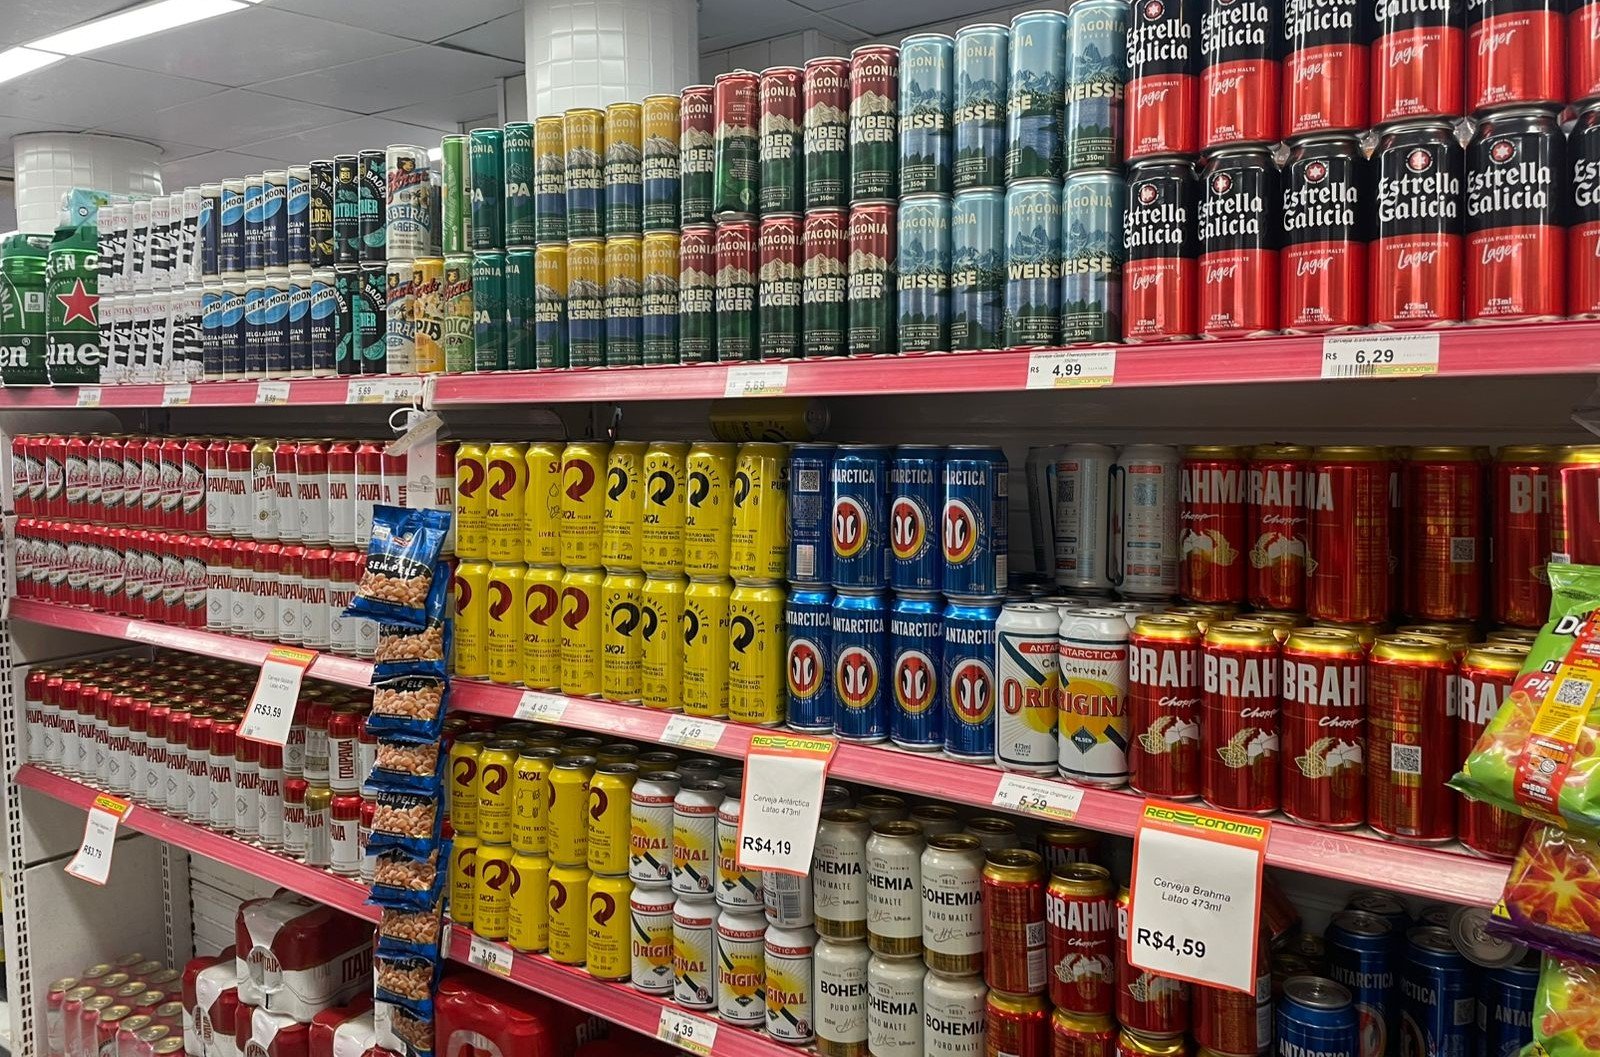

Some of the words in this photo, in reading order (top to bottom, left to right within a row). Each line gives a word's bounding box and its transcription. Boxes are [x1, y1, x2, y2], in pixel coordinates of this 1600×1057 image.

[1200, 2, 1268, 35] Estrella
[1284, 6, 1353, 40] Galicia
[1126, 19, 1192, 49] Estrella
[1201, 24, 1265, 55] Galicia
[1126, 39, 1189, 68] Galicia
[1377, 172, 1460, 203] Estrella
[1467, 162, 1551, 193] Estrella
[1198, 192, 1263, 222] Estrella
[1283, 182, 1358, 211] Estrella
[1467, 185, 1548, 217] Galicia
[1123, 203, 1187, 229] Estrella
[1284, 205, 1355, 232] Galicia
[1379, 195, 1458, 223] Galicia
[1124, 223, 1184, 250] Galicia
[1198, 212, 1260, 241] Galicia
[1398, 248, 1438, 269] Lager
[1482, 242, 1523, 265] Lager
[1008, 259, 1060, 280] WEISS
[1206, 264, 1239, 284] Lager
[1296, 256, 1334, 277] Lager
[1355, 349, 1395, 364] 6,29
[1030, 366, 1040, 374] R$
[1052, 363, 1082, 378] 4,99
[368, 560, 389, 571] SEM
[391, 564, 417, 578] PELE
[833, 619, 884, 638] ANTARCTICA
[604, 643, 625, 655] SKOL
[1065, 663, 1108, 678] Cerveja
[1129, 644, 1200, 688] BRAH
[1203, 653, 1279, 698] BRAH
[1283, 659, 1366, 707] BRAH
[680, 727, 701, 738] 4,49
[1319, 716, 1366, 729] Chopp
[518, 770, 542, 781] SKOL
[378, 792, 396, 802] SEM
[753, 794, 777, 805] Cerveja
[1019, 795, 1048, 810] 5,29
[782, 807, 801, 816] 473ml
[743, 836, 791, 855] R$4,19
[922, 885, 983, 906] BOHEMIA
[1153, 877, 1191, 893] Cerveja
[1192, 886, 1231, 903] Brahma
[879, 896, 902, 907] MALTE
[1046, 892, 1114, 932] BRAHM
[1191, 899, 1222, 913] 473ml
[929, 910, 946, 921] PURO
[948, 912, 973, 923] MALTE
[1068, 937, 1106, 948] Chopp
[1137, 928, 1206, 959] R$4,59
[482, 949, 497, 963] 3,69
[821, 980, 868, 997] BOHEM
[831, 1003, 850, 1012] PURO
[674, 1023, 693, 1037] 4,39
[884, 1021, 906, 1031] MALTE
[934, 1040, 951, 1050] PURO
[954, 1042, 979, 1052] MALTE
